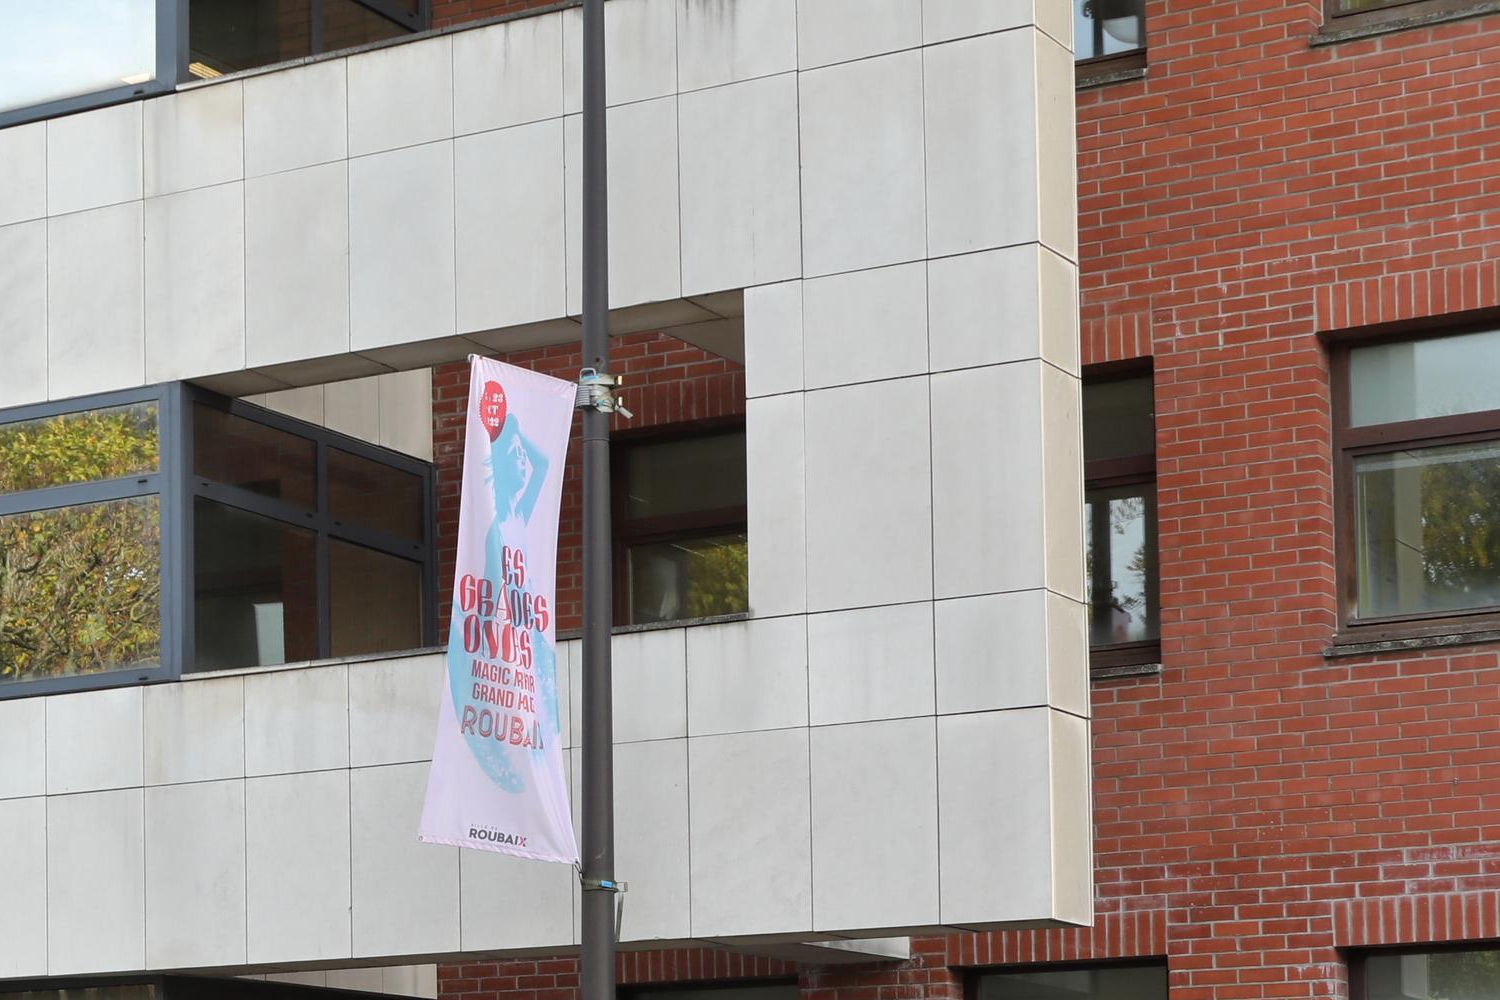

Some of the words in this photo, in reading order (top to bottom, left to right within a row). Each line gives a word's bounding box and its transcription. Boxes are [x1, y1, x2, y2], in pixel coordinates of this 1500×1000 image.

[501, 545, 525, 589] ES
[460, 574, 549, 632] GRADES
[471, 659, 510, 685] MAGIC
[472, 682, 514, 709] GRAND
[469, 828, 527, 847] ROUBAIX
